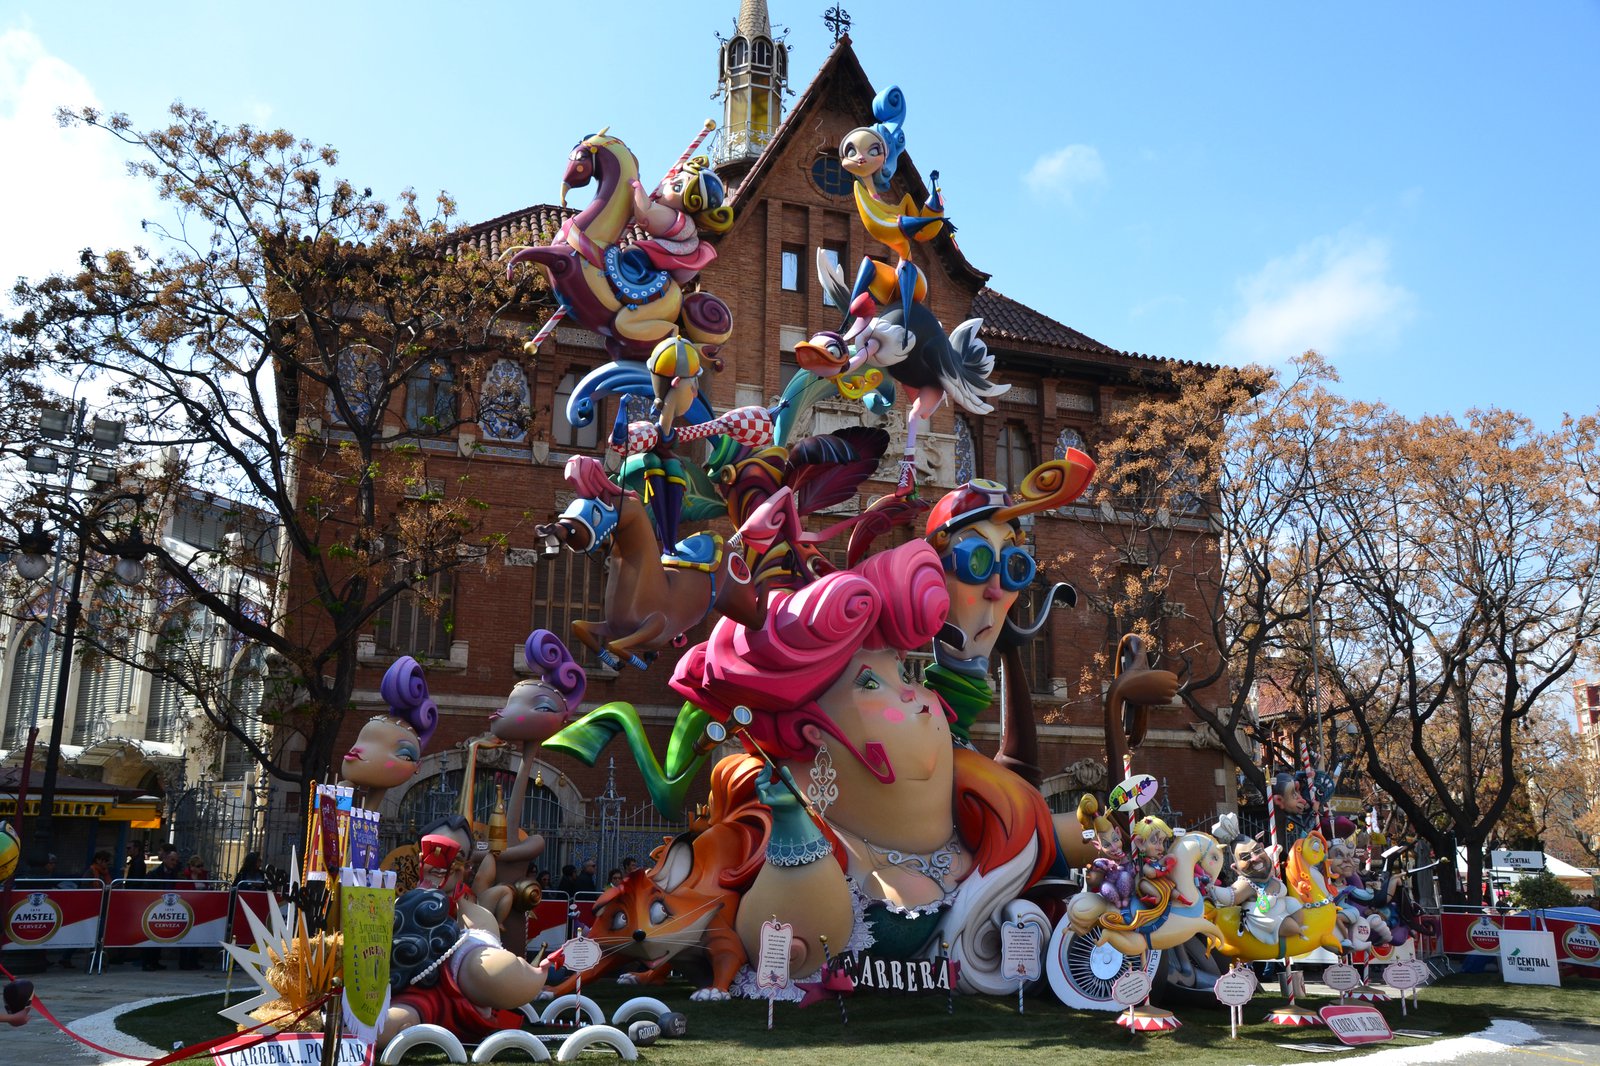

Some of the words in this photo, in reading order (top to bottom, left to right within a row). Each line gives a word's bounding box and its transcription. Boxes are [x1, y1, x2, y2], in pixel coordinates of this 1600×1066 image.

[14, 913, 54, 921] AMSTEL
[151, 912, 187, 920] AMSTEL
[1569, 938, 1598, 947] AMSTEL
[1517, 957, 1550, 967] CENTRAL
[844, 955, 950, 992] CARRERA
